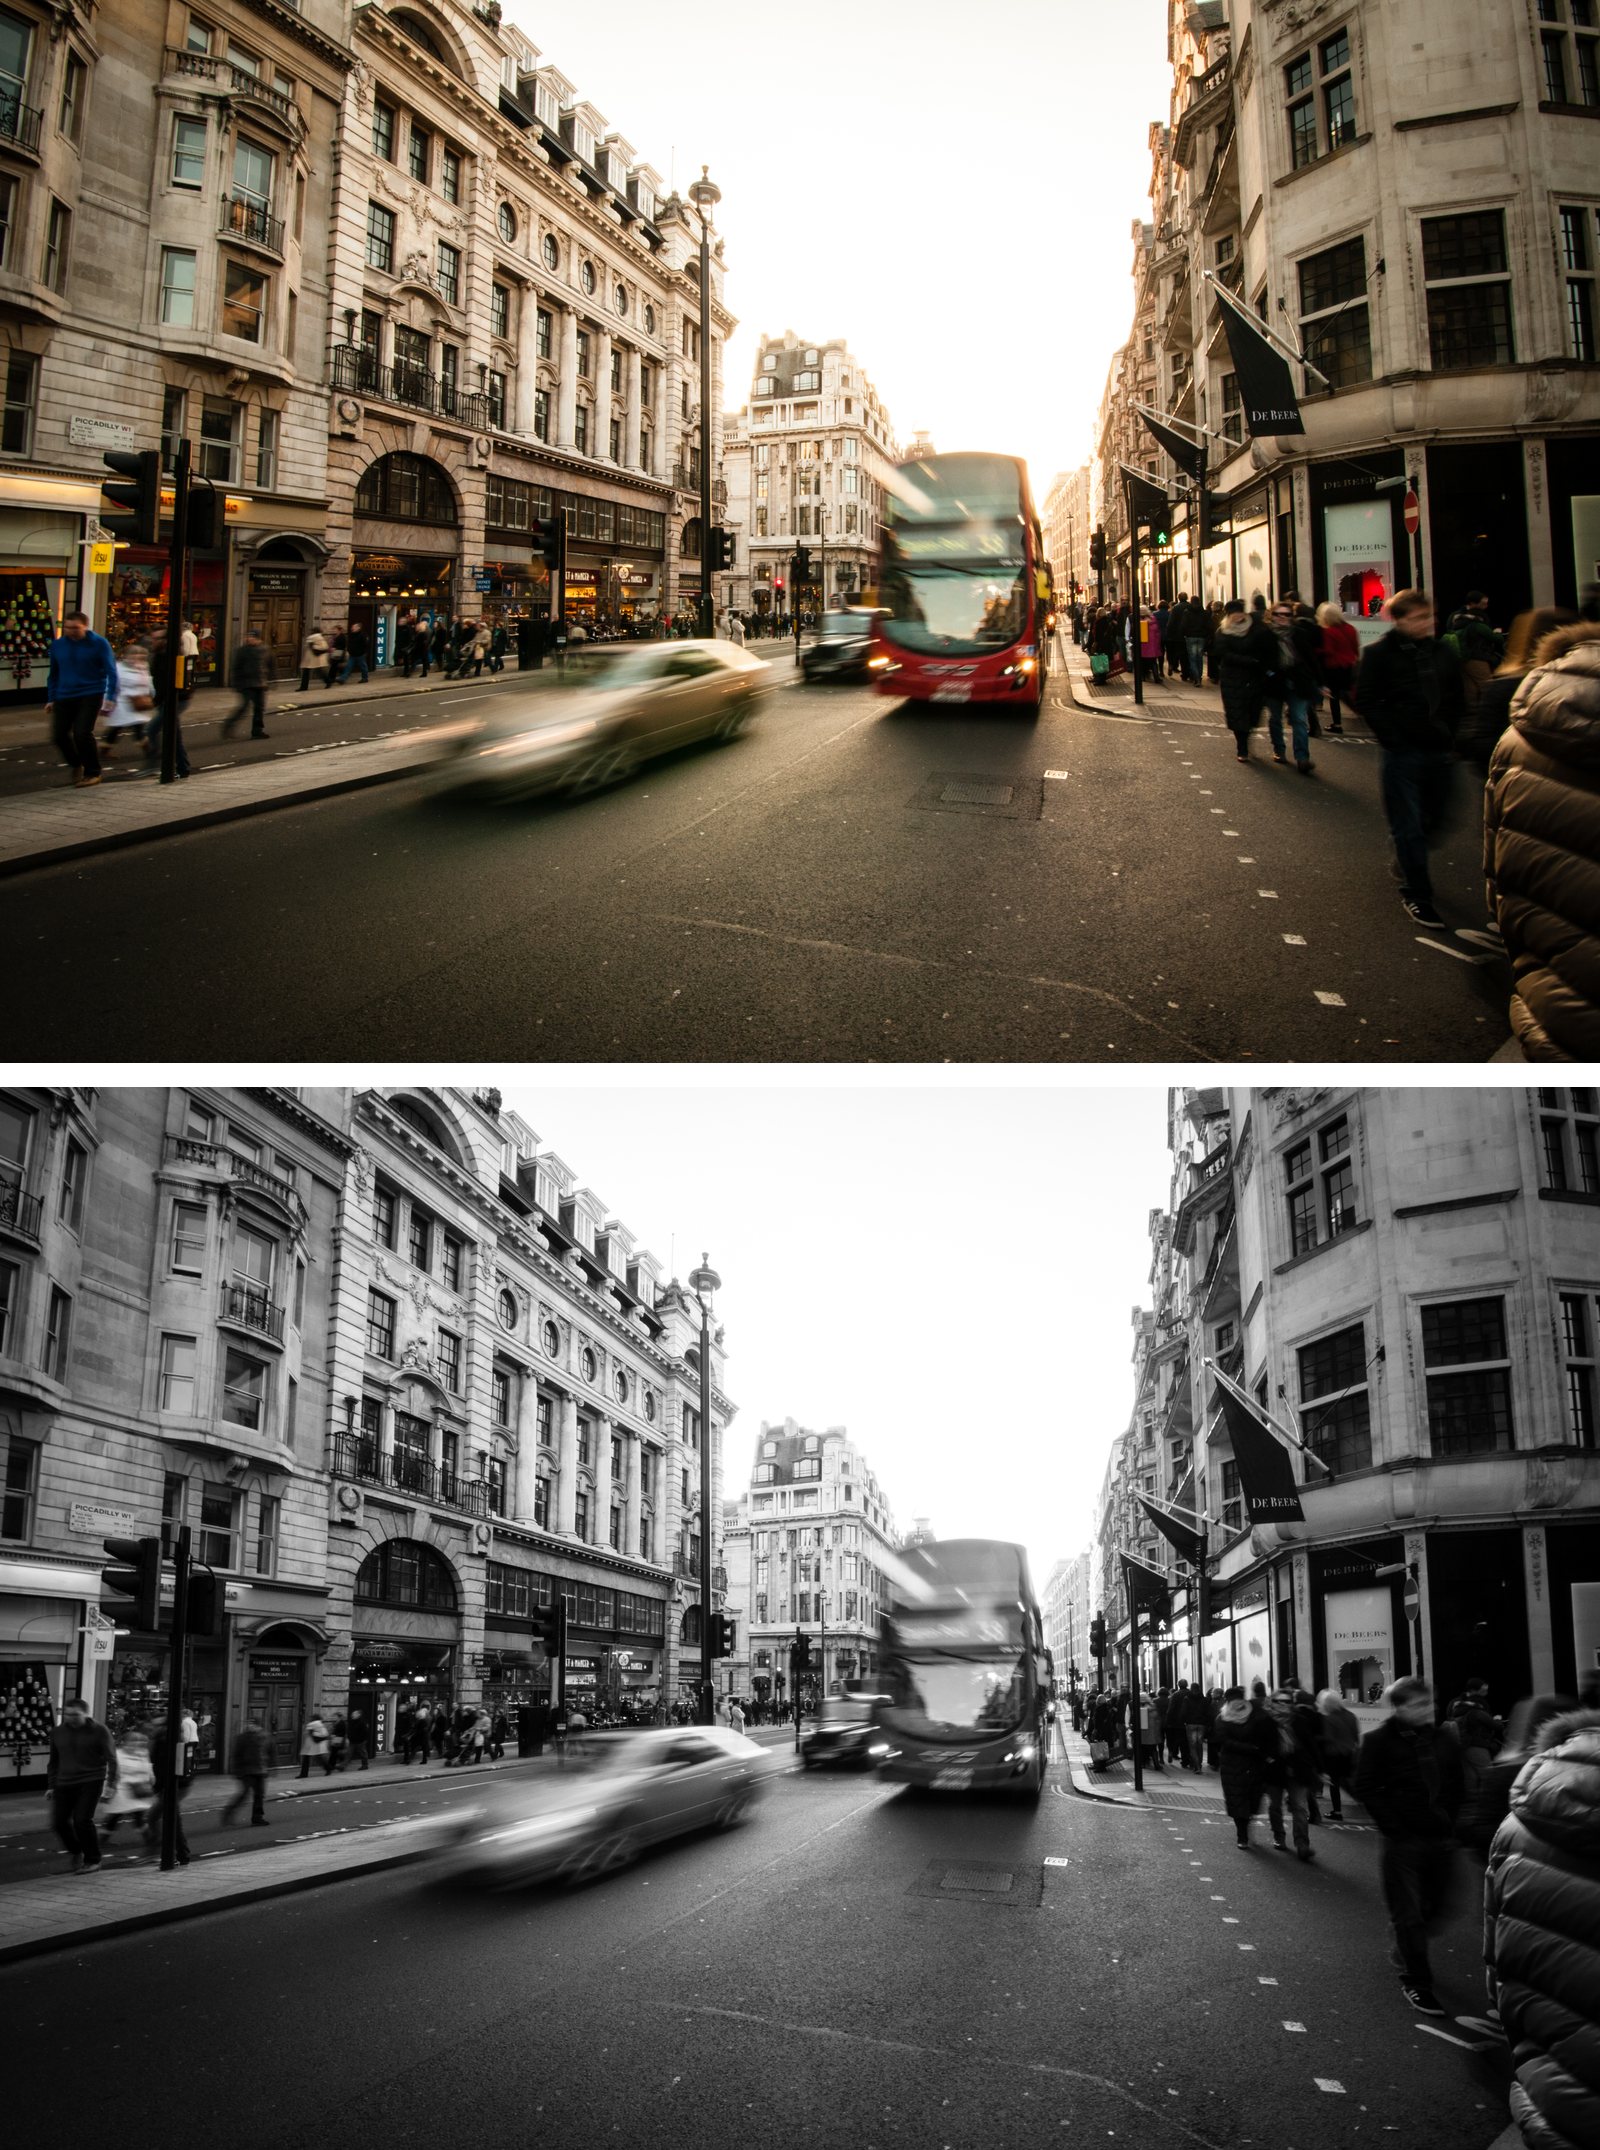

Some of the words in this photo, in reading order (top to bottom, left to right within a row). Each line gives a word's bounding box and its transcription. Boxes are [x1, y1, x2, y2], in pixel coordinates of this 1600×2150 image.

[1252, 410, 1269, 422] DE
[1270, 409, 1298, 421] BEERS
[75, 417, 120, 430] PICCADILLY
[1351, 543, 1388, 551] BEERS
[376, 617, 385, 664] MONEY
[1252, 1497, 1269, 1509] DE
[75, 1504, 120, 1517] PICCADILLY
[376, 1704, 385, 1751] MONEY
